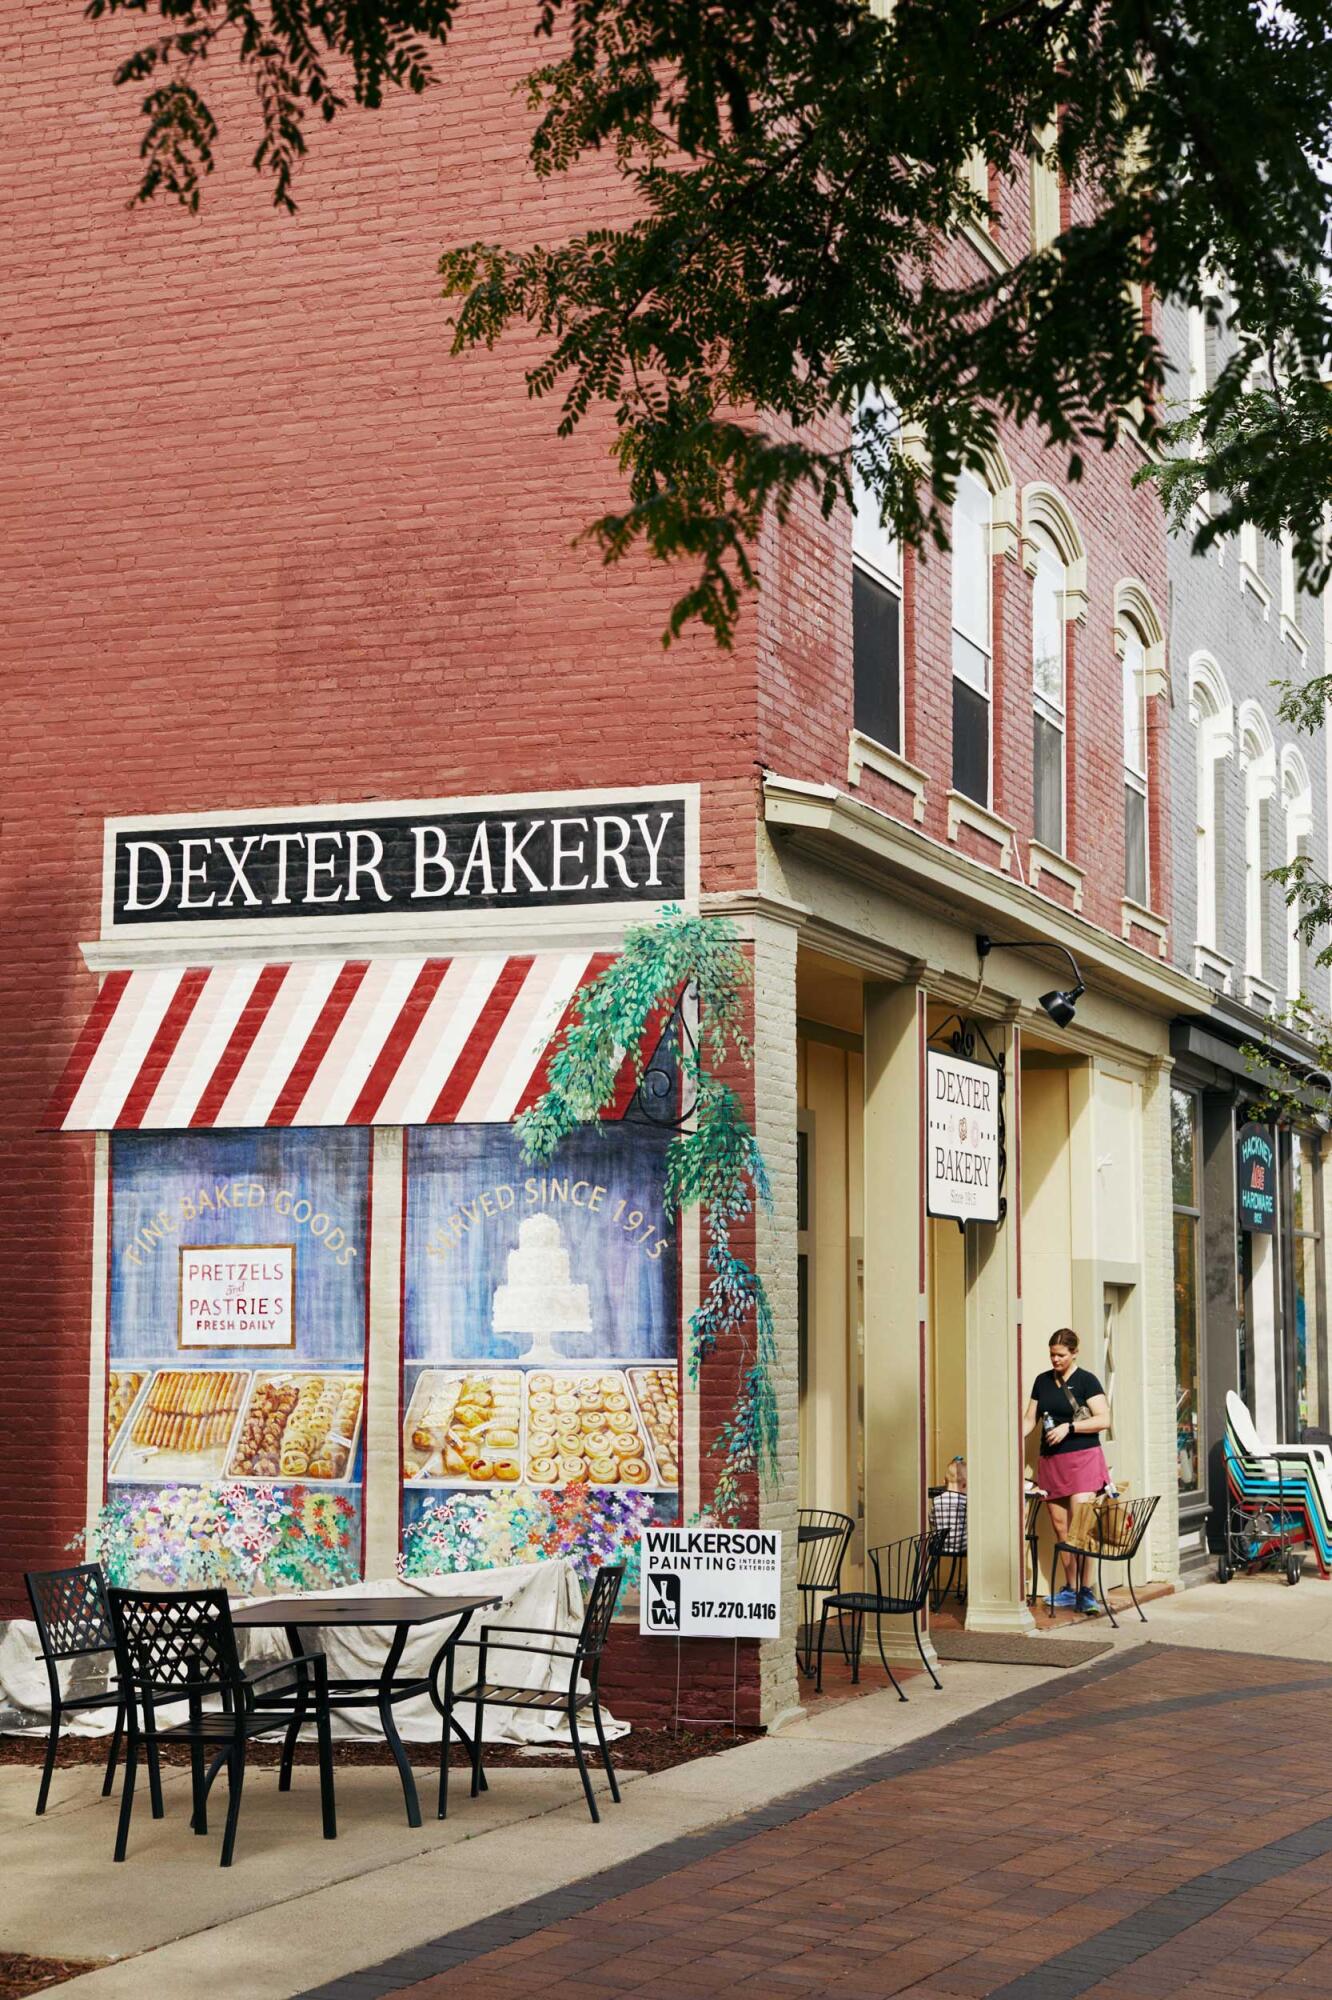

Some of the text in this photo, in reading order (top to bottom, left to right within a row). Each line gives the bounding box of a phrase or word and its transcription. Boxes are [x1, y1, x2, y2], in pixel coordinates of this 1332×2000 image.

[123, 812, 674, 912] DEXTER BAKERY
[936, 1068, 990, 1112] DEXTER
[1242, 1136, 1272, 1168] HACKNEY
[935, 1147, 991, 1187] BAKERY
[1242, 1190, 1273, 1212] HARDWARE
[125, 1183, 357, 1266] FINE BAKED GOODS
[525, 1178, 607, 1212] SINCE
[612, 1199, 669, 1260] 1915
[189, 1264, 284, 1281] PRETZELS
[225, 1282, 245, 1295] and
[190, 1298, 283, 1316] PASTRIES
[196, 1320, 275, 1331] FRESH DAILY
[646, 1533, 776, 1555] WILKERSON
[649, 1556, 736, 1571] PAINTING
[691, 1601, 776, 1620] 517.270.1416
